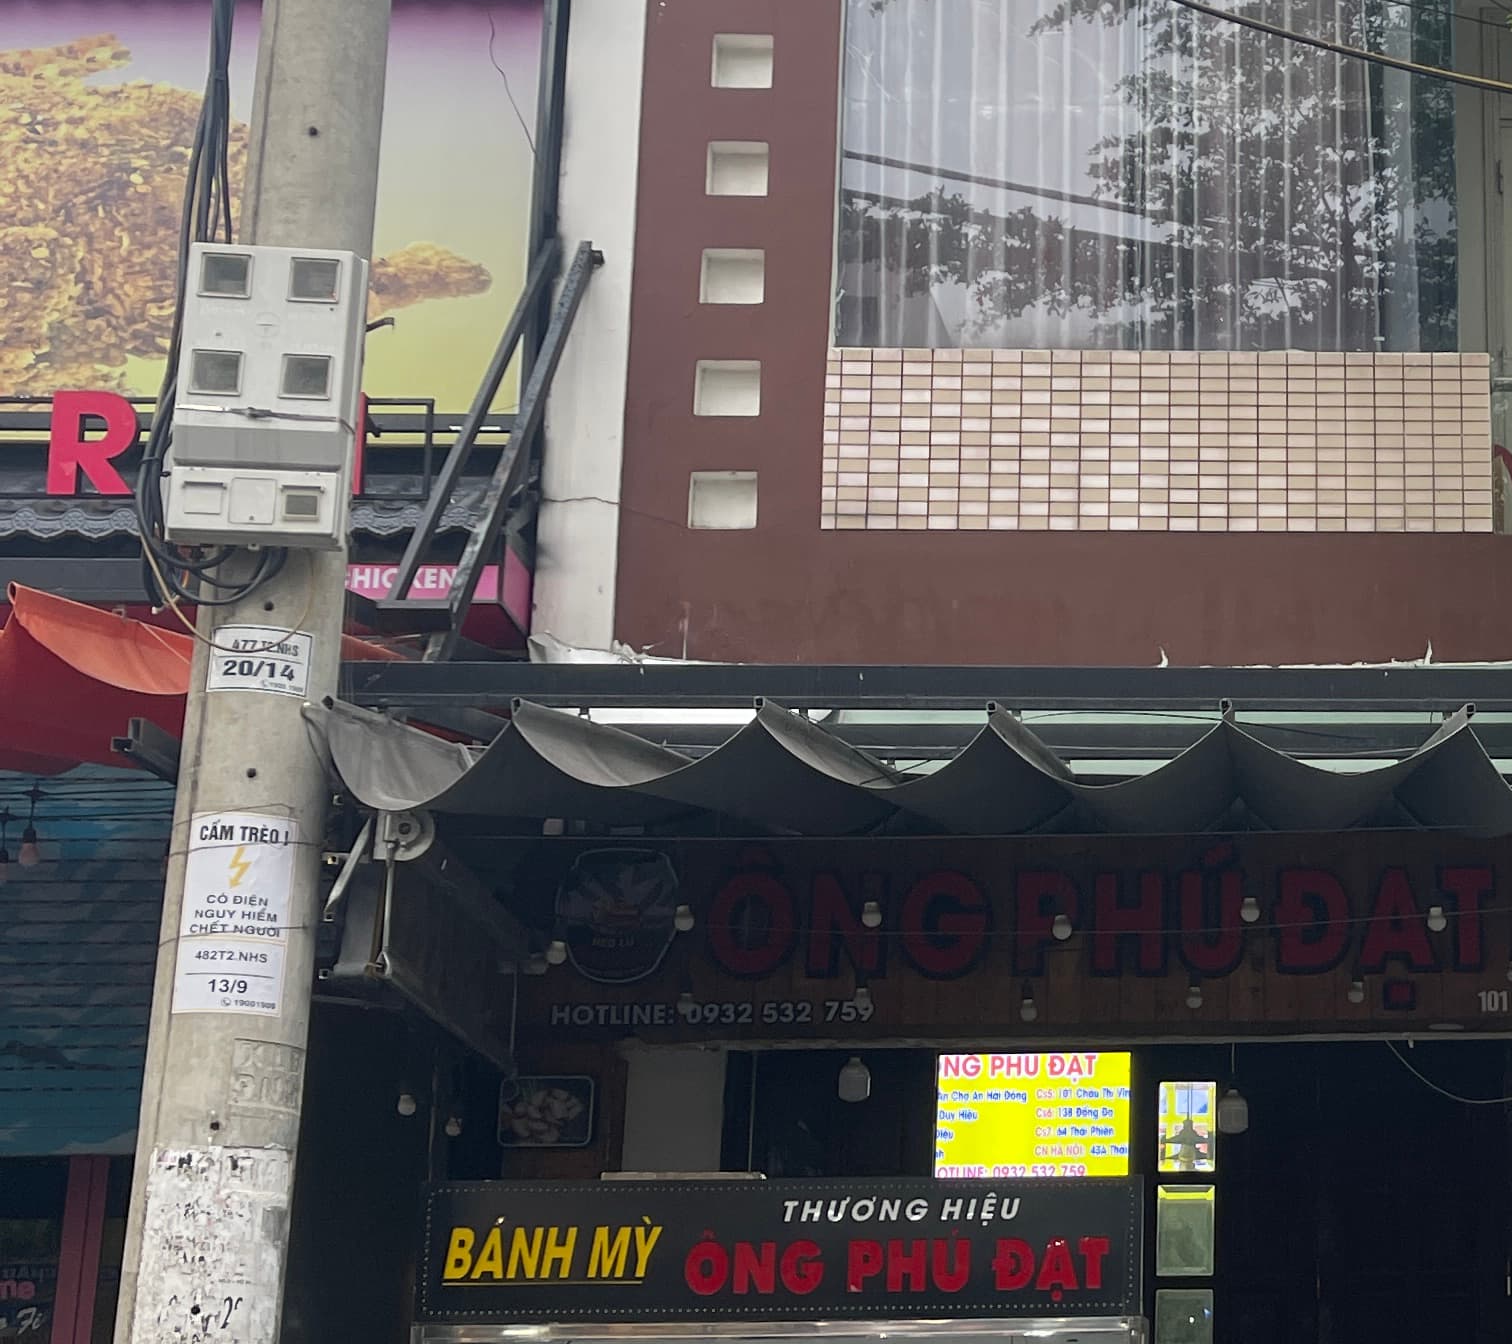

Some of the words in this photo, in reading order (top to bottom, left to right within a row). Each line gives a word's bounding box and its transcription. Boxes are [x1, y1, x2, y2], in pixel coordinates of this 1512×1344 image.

[223, 659, 295, 681] 20/14
[199, 819, 234, 841] CẤM
[240, 824, 280, 845] TRÈO
[194, 910, 236, 920] NGUY
[709, 847, 993, 977] ÔNG
[1010, 843, 1245, 976] PHÚ
[1275, 866, 1494, 1010] ĐẠT
[207, 978, 249, 994] 13/9
[550, 1003, 675, 1025] HOTLINE:
[762, 1002, 813, 1024] 532
[824, 1000, 875, 1024] 759
[1478, 989, 1510, 1013] 101
[782, 1196, 929, 1223] THƯƠNG
[941, 1191, 1022, 1227] HIỆU
[443, 1215, 576, 1281] BÁNH
[587, 1215, 662, 1280] MỲ
[684, 1229, 826, 1295] ÔNG
[846, 1228, 971, 1294] PHÚ
[991, 1235, 1112, 1302] ĐẠT
